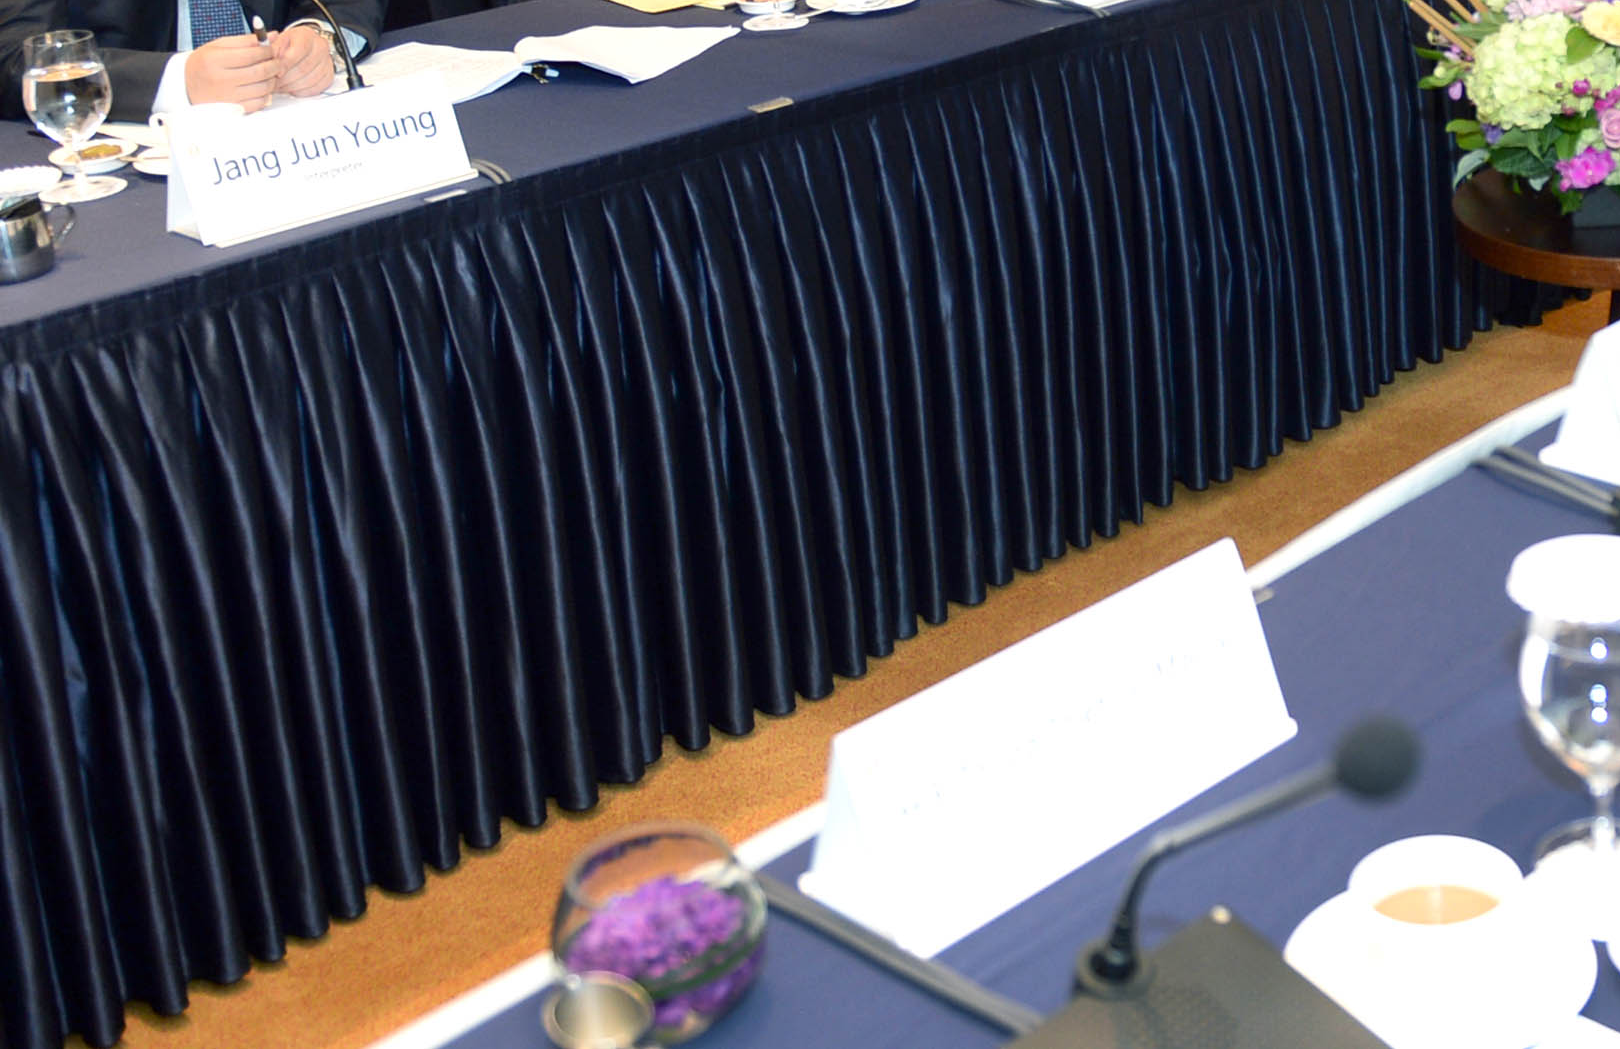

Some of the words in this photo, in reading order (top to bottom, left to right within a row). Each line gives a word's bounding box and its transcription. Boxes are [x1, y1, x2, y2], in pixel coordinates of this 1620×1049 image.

[212, 149, 283, 186] Jang
[290, 135, 341, 165] Jun
[343, 110, 438, 149] Young
